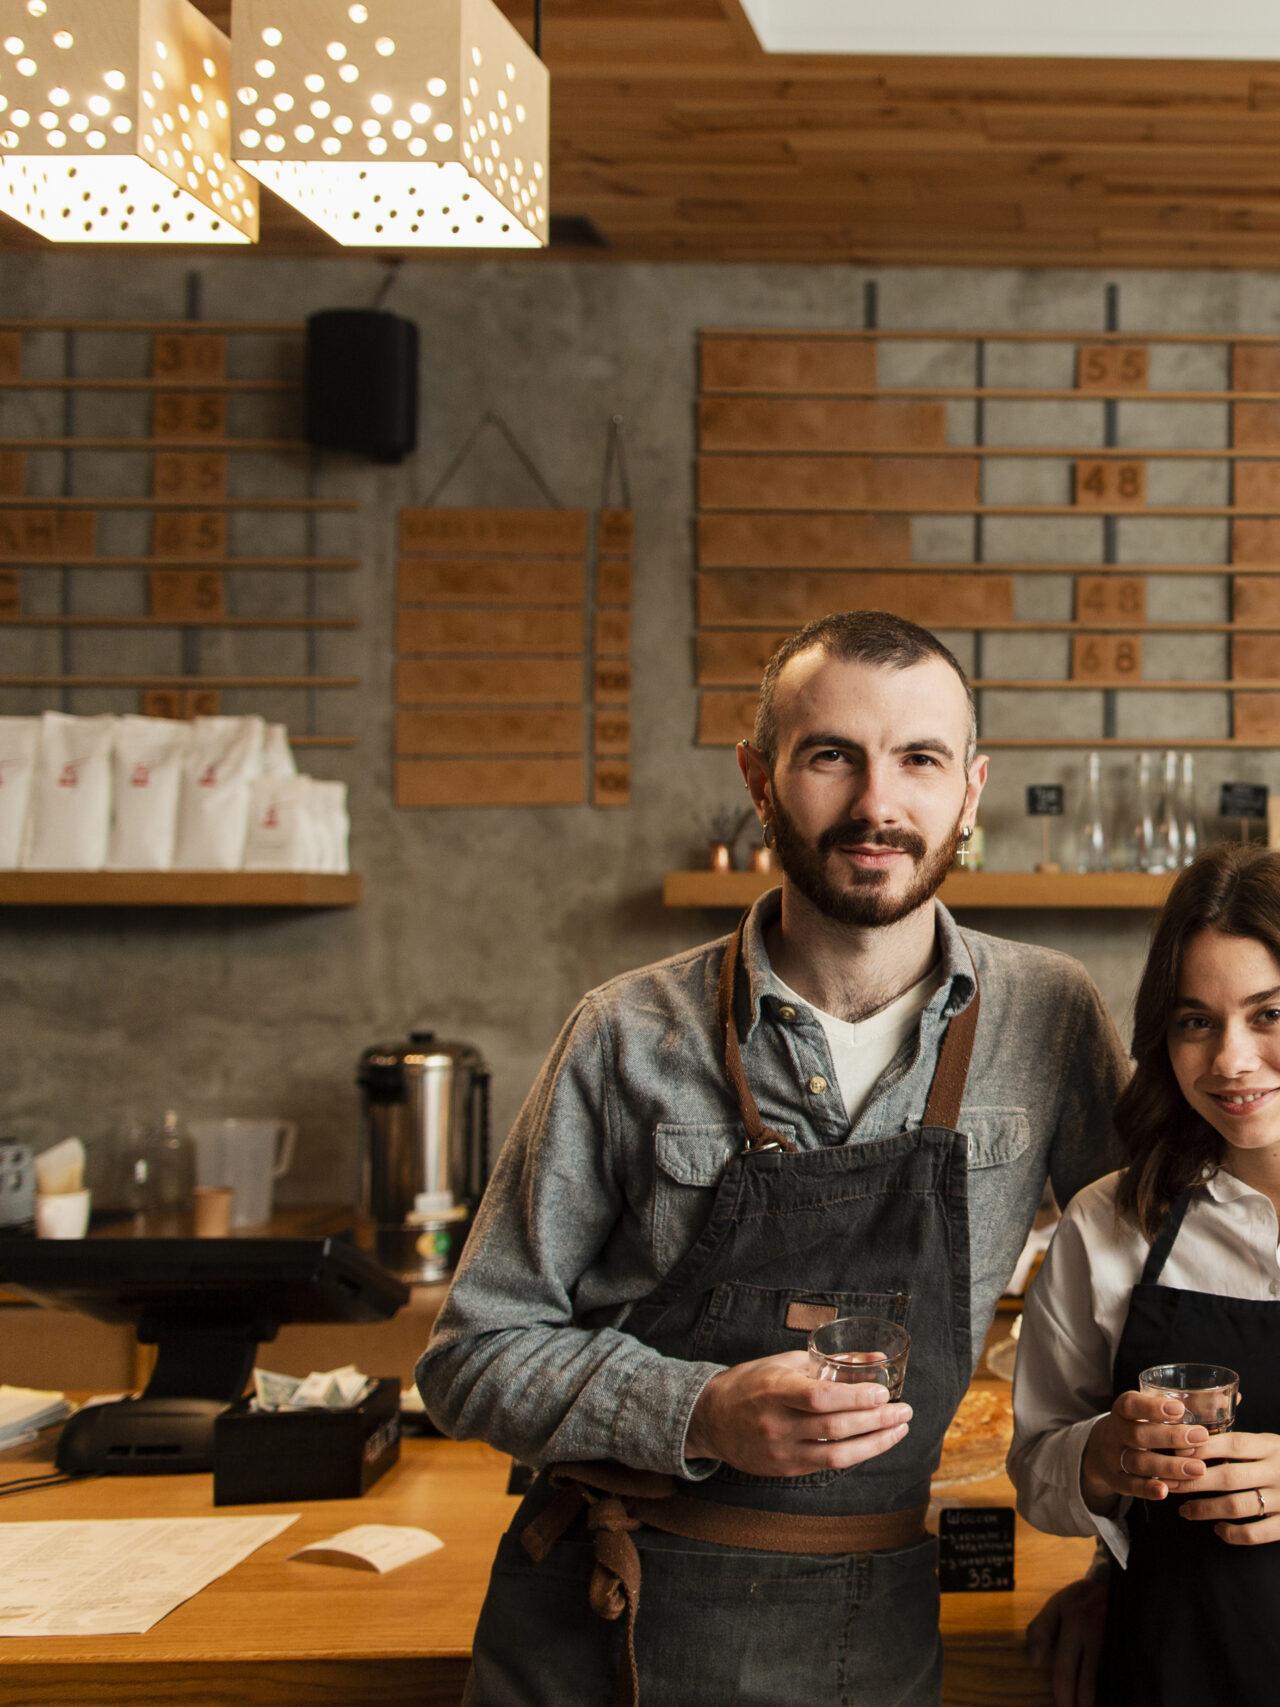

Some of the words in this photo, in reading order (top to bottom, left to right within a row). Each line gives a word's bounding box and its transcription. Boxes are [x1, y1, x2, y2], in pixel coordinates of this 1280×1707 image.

[1087, 352, 1145, 380] 55
[1081, 467, 1141, 498] 48
[1079, 644, 1136, 674] 68
